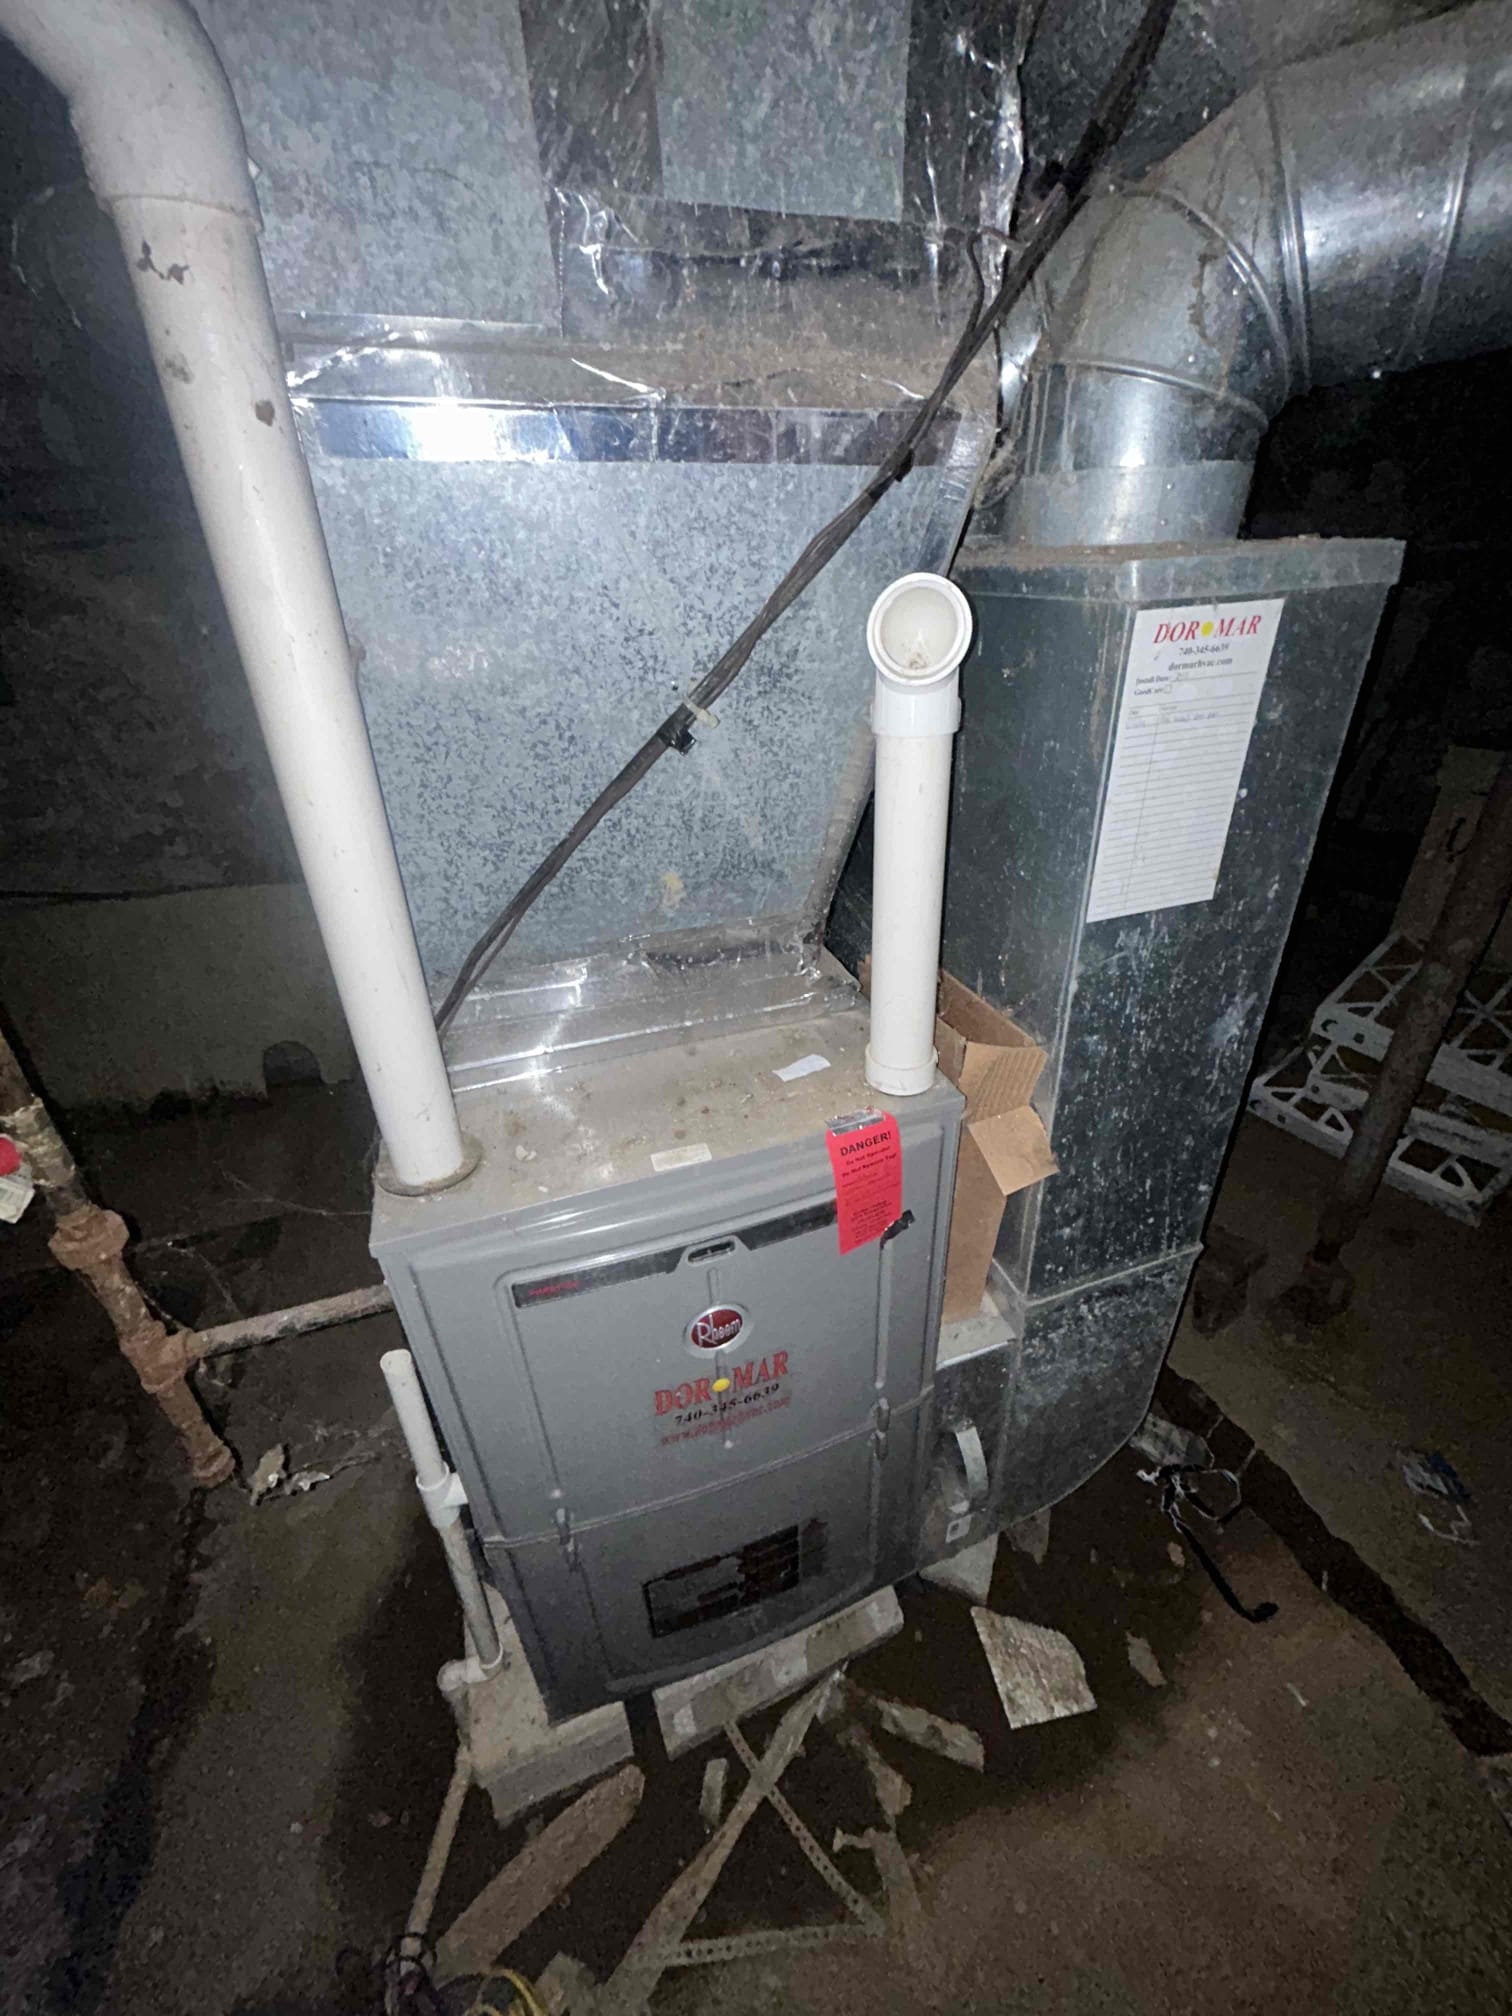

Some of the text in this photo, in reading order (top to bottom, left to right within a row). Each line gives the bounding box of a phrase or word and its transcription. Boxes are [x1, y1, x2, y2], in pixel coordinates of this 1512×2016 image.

[1153, 615, 1262, 644] DOR MAR
[839, 1131, 892, 1156] DANGER!
[695, 1313, 741, 1348] Rheem
[654, 1350, 789, 1417] DOR MAR
